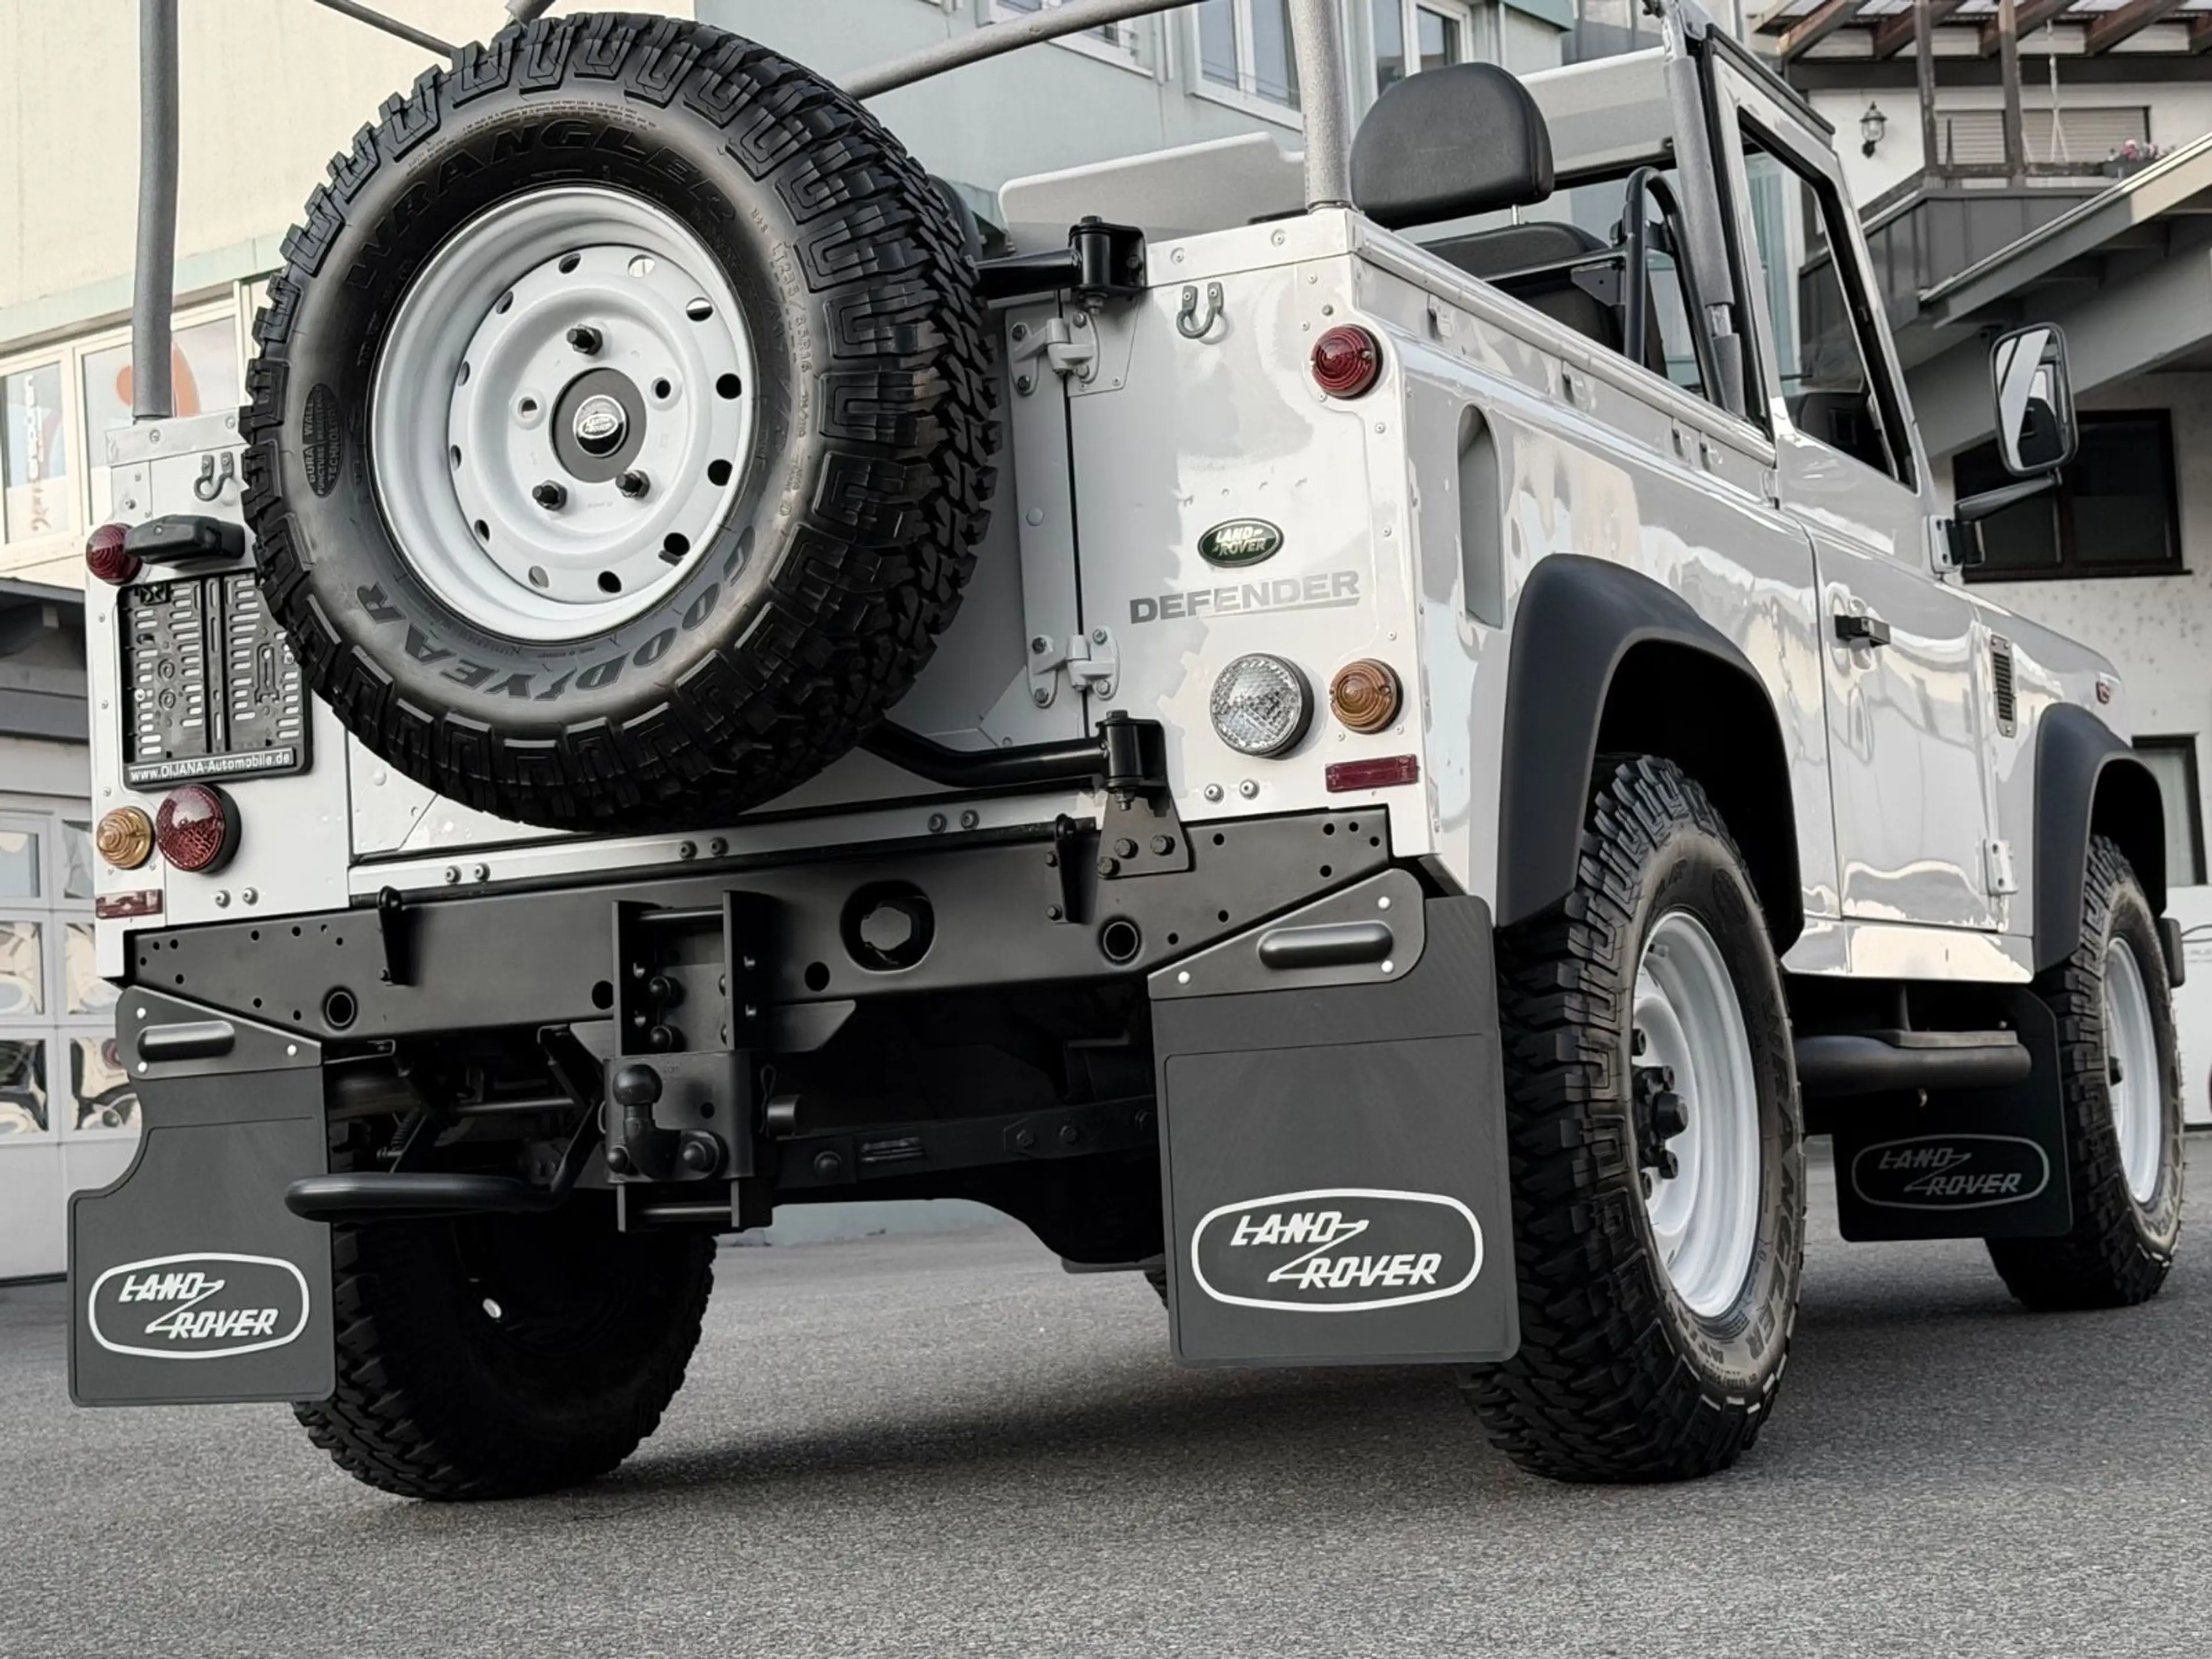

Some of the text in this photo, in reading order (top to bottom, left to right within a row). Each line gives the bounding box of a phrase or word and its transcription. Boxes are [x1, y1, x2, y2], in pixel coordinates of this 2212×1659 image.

[346, 118, 737, 291] WRANGLER
[304, 399, 315, 436] WALL
[328, 404, 340, 482] TECHNOLO
[1215, 526, 1254, 543] LAND
[1218, 537, 1267, 557] ROVER
[355, 524, 756, 702] GOODYEAR
[1130, 570, 1361, 624] DEFENDER
[1877, 1147, 1953, 1170] LAND
[1925, 1172, 2022, 1196] ROVER
[1230, 1211, 1342, 1247] LAND
[119, 1271, 206, 1303] LAND
[1298, 1253, 1442, 1290] ROVER
[168, 1308, 279, 1339] ROVER
